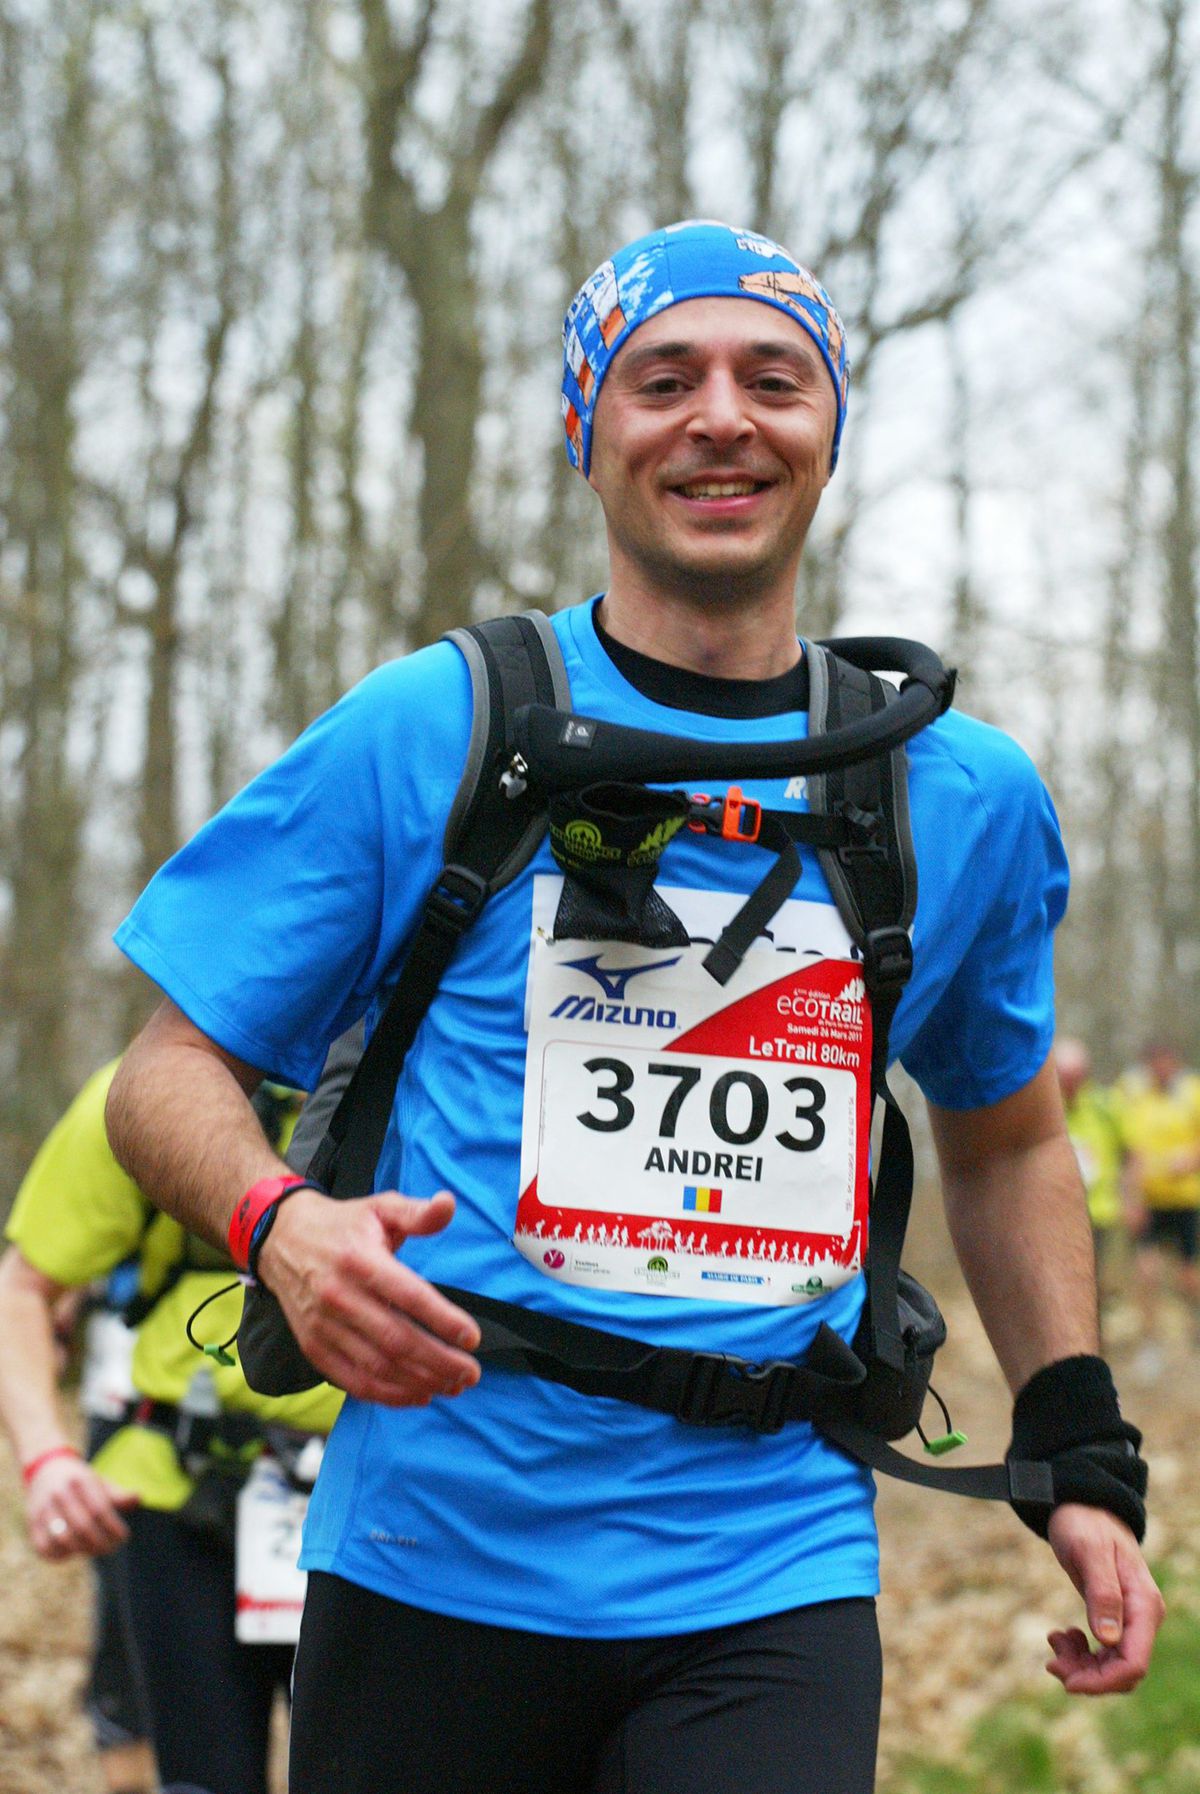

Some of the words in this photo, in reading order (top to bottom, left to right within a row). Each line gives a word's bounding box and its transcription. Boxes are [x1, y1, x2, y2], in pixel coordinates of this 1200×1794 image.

[783, 776, 809, 800] R
[549, 994, 677, 1029] MIZUNO
[787, 1023, 819, 1036] Samedi
[831, 1029, 847, 1041] Mars
[847, 1031, 863, 1043] 2011
[820, 1044, 860, 1068] 80km
[576, 1056, 827, 1153] 3703
[643, 1146, 763, 1183] ANDREI
